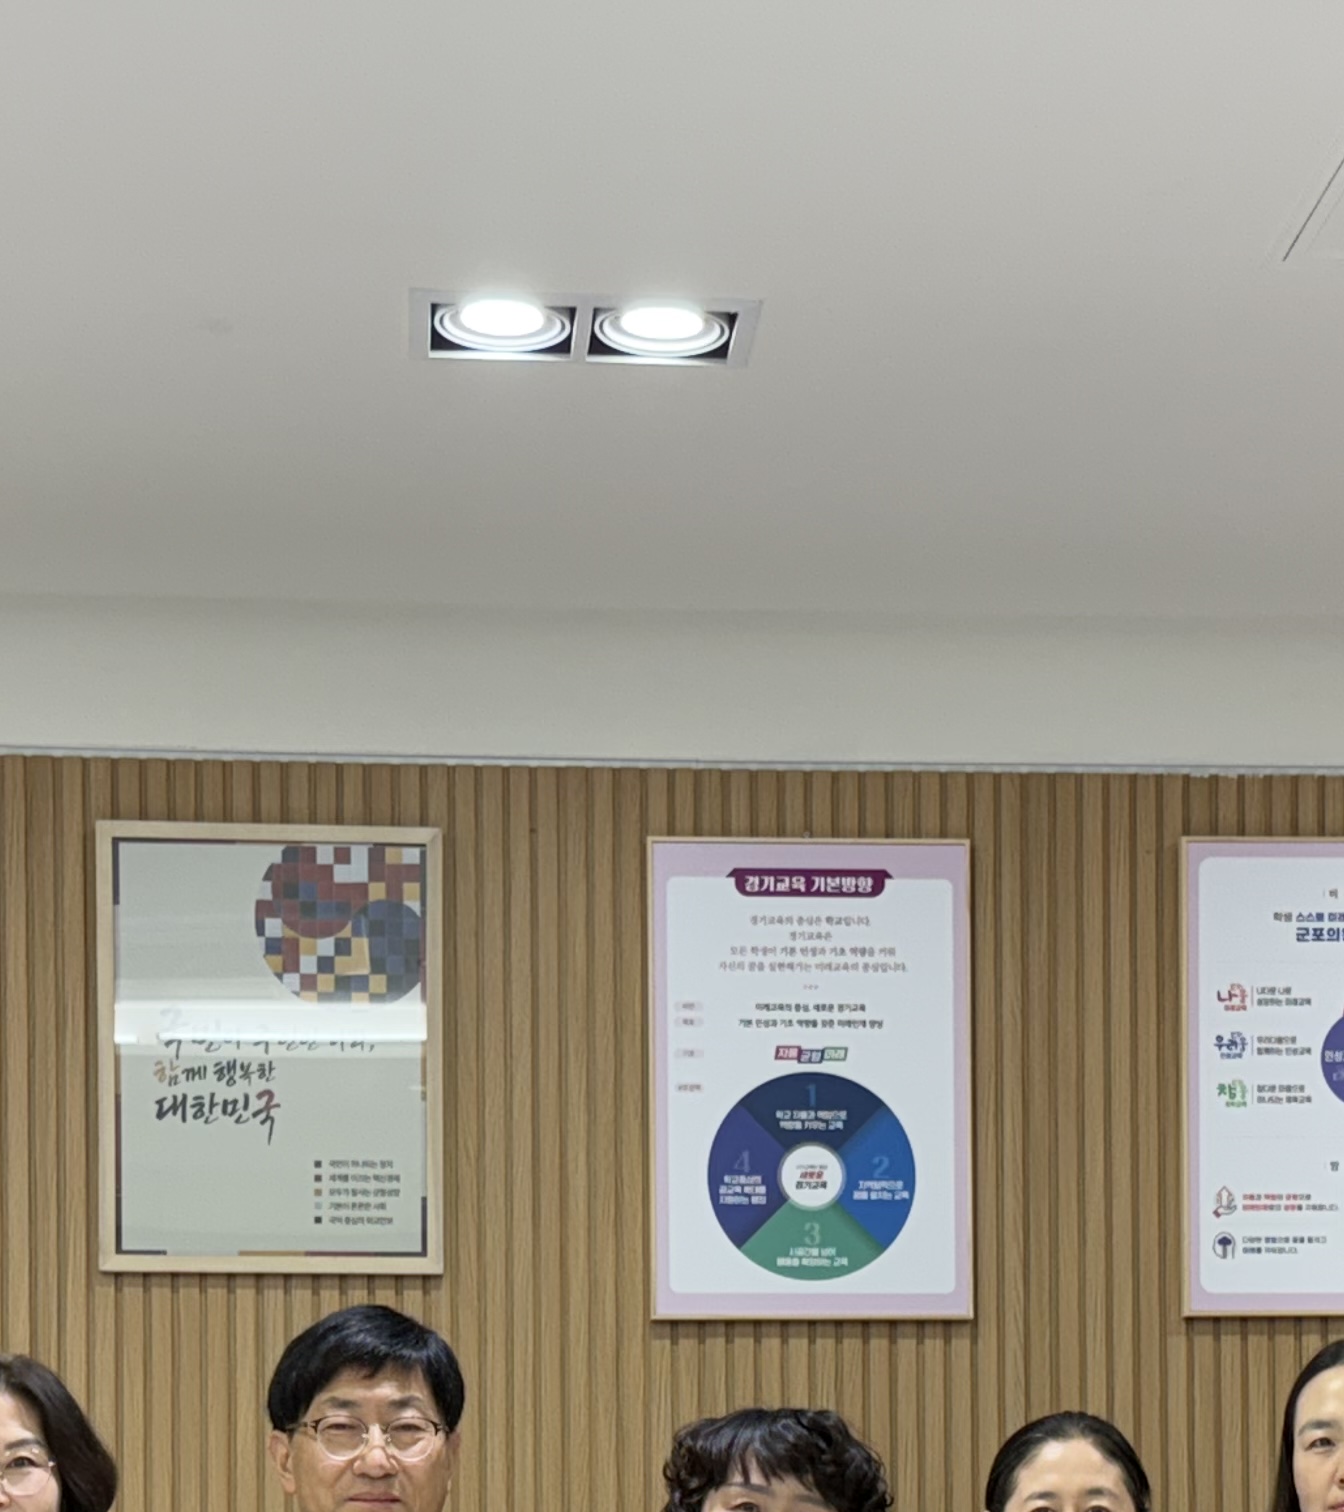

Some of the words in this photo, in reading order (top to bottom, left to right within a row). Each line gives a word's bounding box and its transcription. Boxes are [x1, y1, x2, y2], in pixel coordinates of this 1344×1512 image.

[744, 875, 806, 893] 경기교육
[810, 875, 873, 894] 기본방향
[1296, 912, 1325, 923] 스스로
[153, 1059, 207, 1087] 함께
[213, 1058, 276, 1087] 행복한
[155, 1088, 281, 1146] 대한민국
